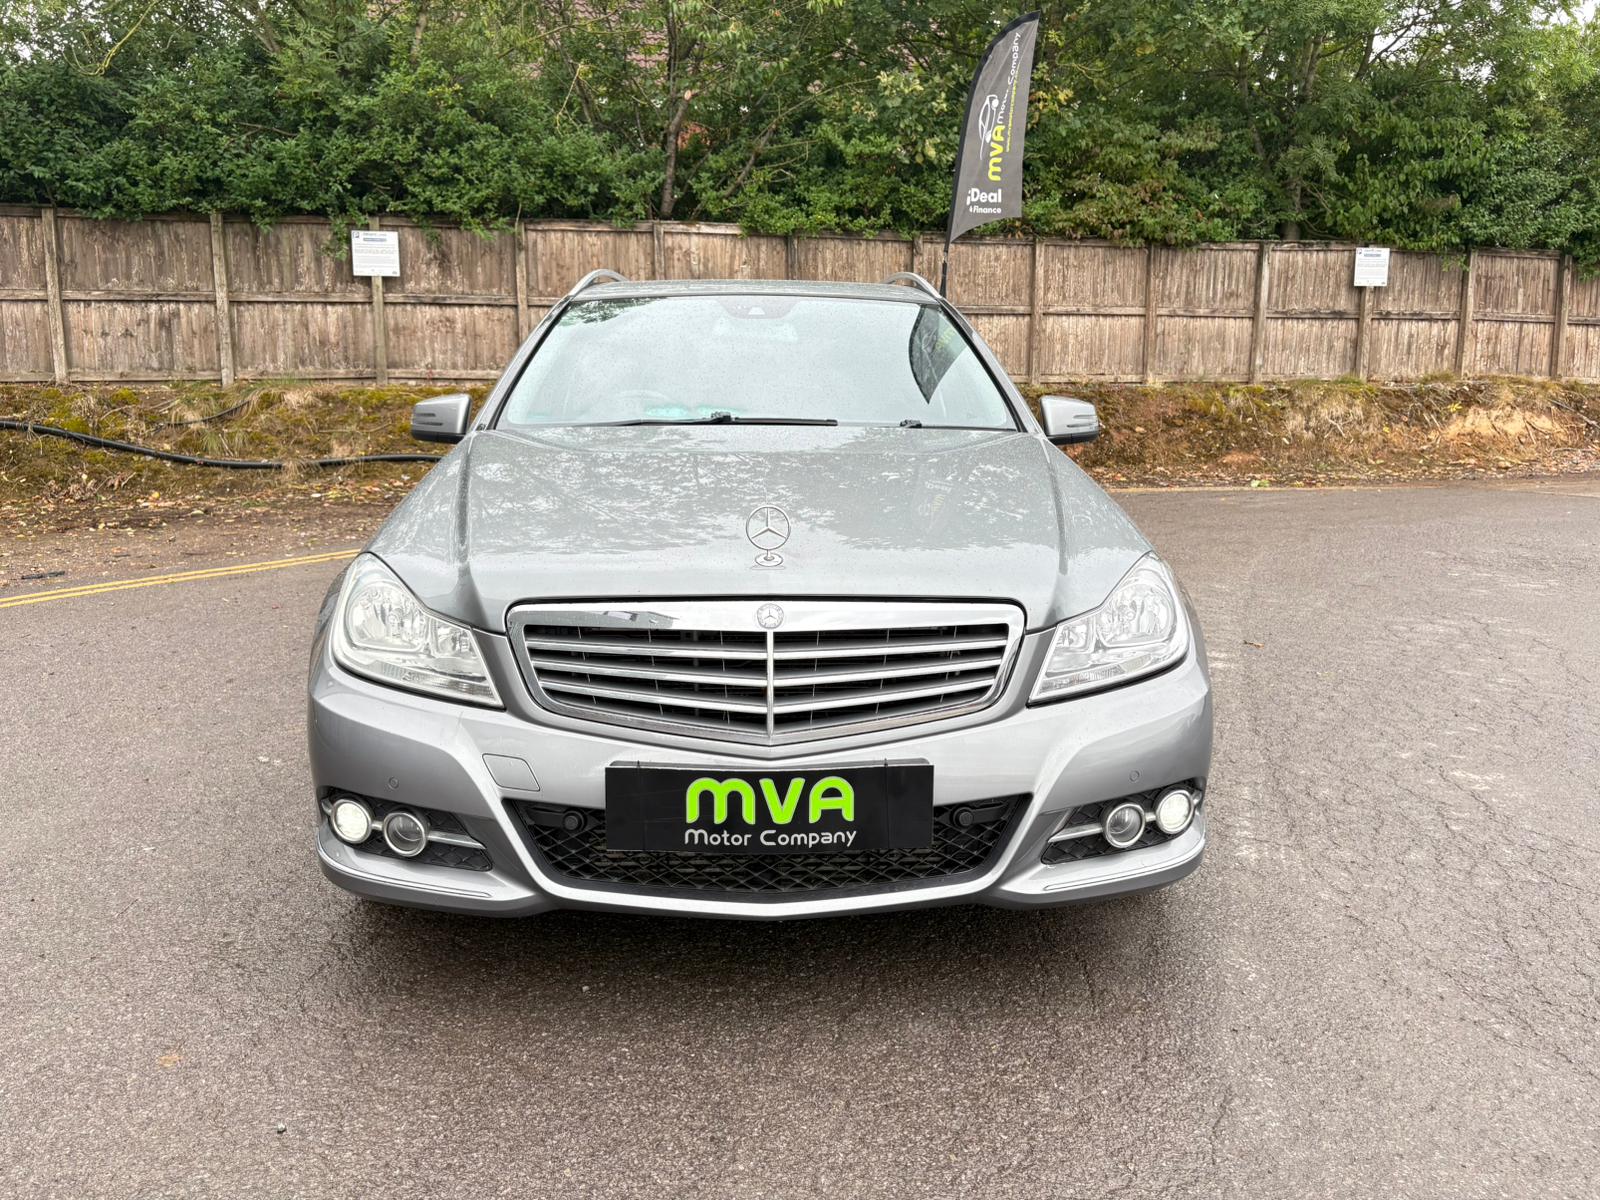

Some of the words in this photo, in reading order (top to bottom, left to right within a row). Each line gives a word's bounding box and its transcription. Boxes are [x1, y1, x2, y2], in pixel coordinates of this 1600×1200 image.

[1007, 32, 1021, 85] Company
[966, 187, 1002, 206] iDeal
[686, 776, 854, 825] MVA
[684, 828, 752, 846] Motor
[760, 829, 857, 849] Company
